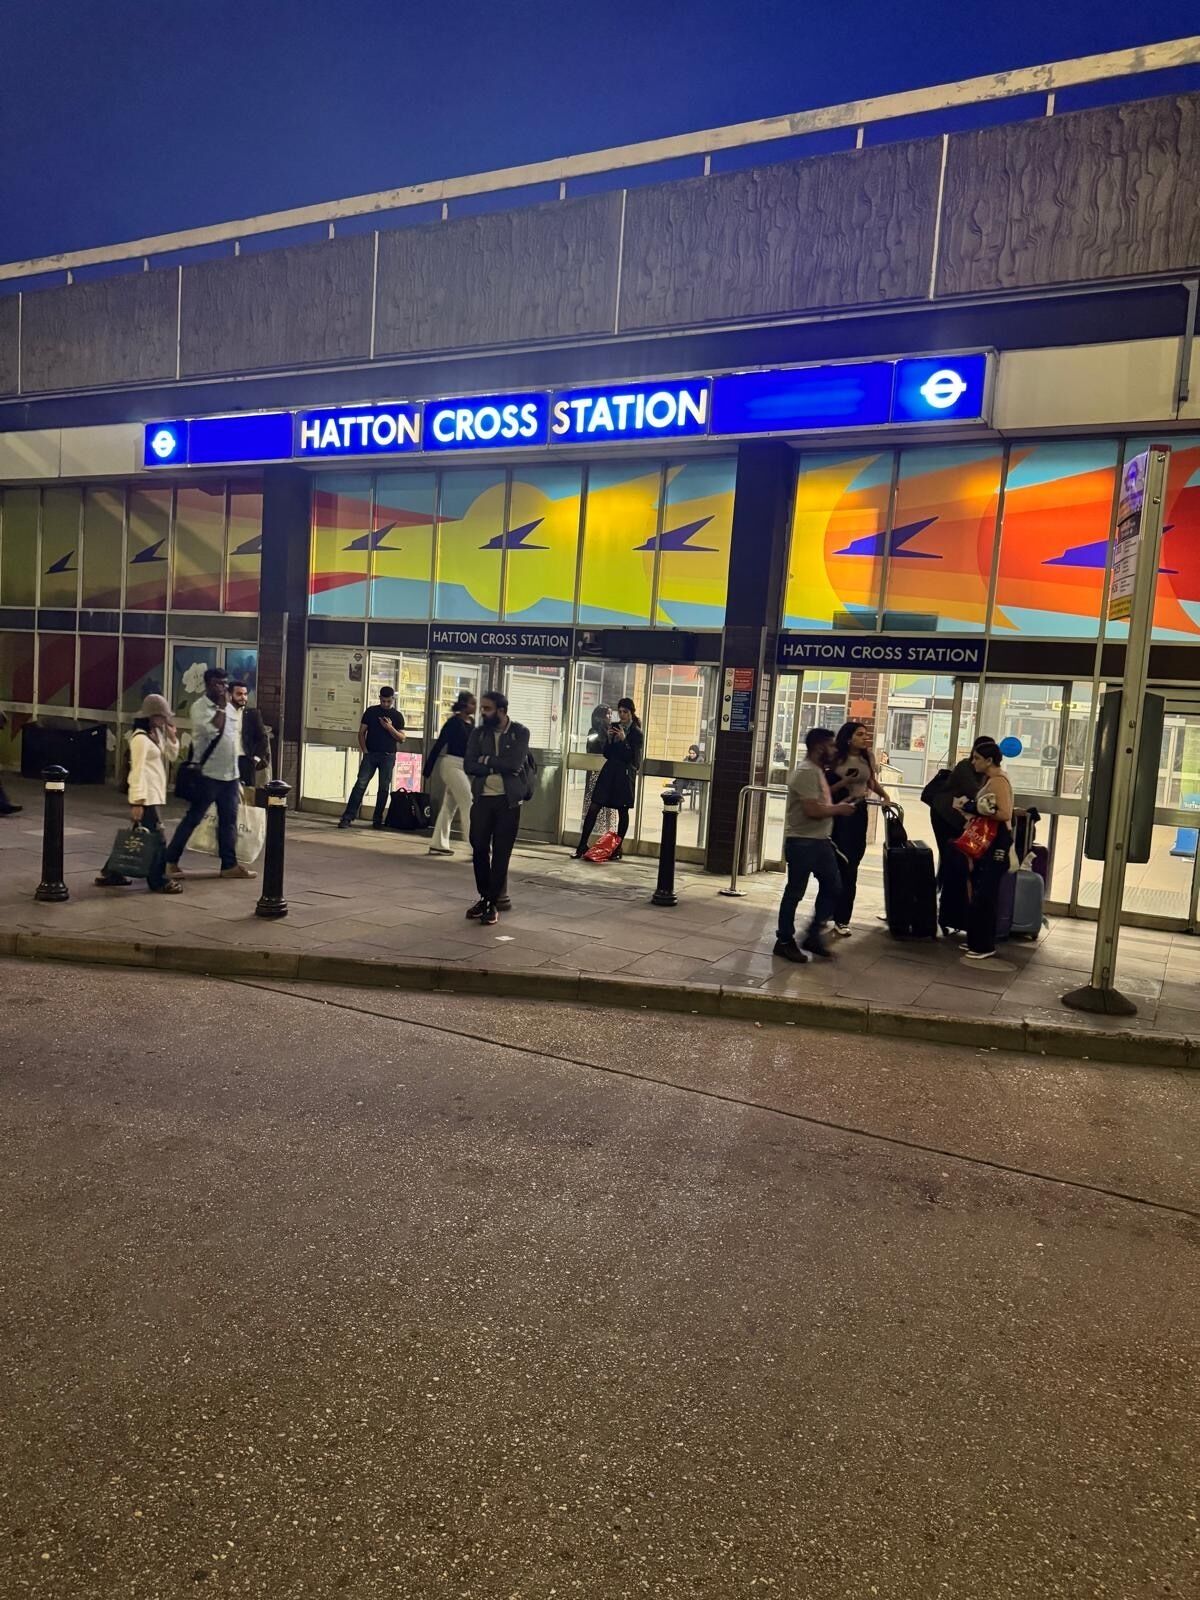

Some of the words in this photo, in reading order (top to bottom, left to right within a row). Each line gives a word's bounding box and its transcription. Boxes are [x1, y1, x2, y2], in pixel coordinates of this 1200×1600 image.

[301, 411, 421, 449] HATTON
[432, 402, 537, 442] CROSS
[552, 389, 707, 434] STATION
[433, 631, 477, 644] HATTON
[481, 633, 517, 646] CROSS
[520, 634, 569, 647] STATION
[783, 644, 845, 658] HATTON
[851, 646, 903, 660] CROSS
[908, 648, 979, 662] STATION
